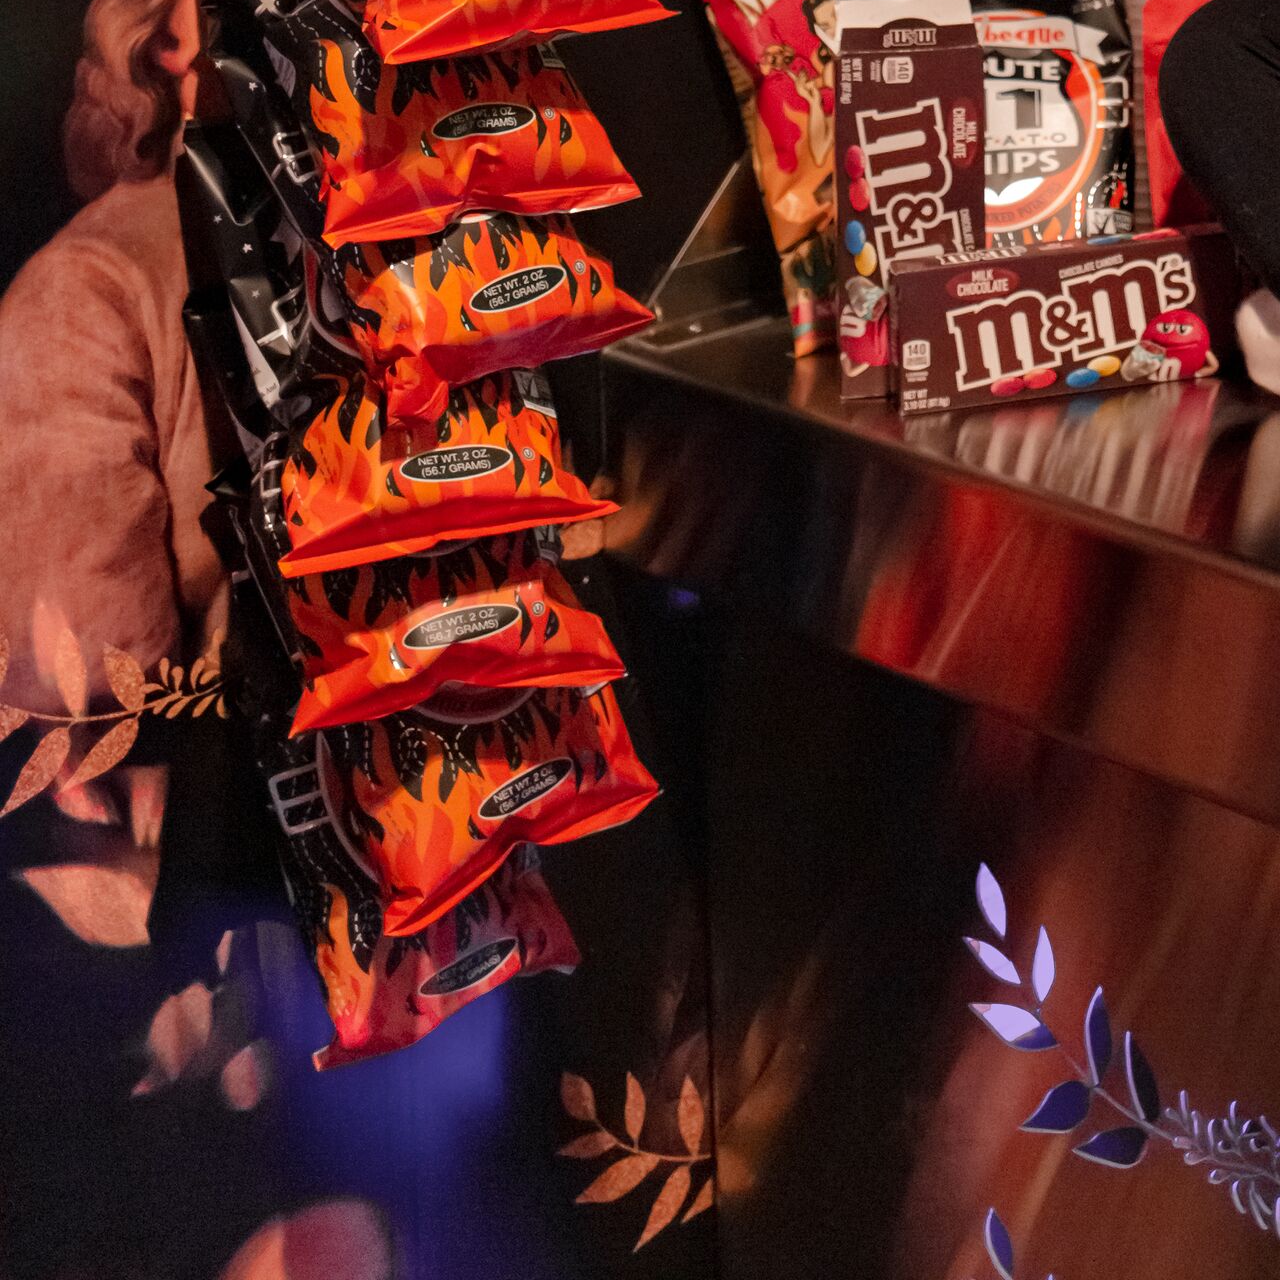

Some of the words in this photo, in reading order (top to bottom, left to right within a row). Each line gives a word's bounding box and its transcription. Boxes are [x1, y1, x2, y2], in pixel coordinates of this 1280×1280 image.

[984, 23, 1065, 47] beque
[897, 61, 910, 80] 140
[983, 56, 1061, 81] UTE
[953, 107, 966, 159] CHOCOLATE
[966, 121, 977, 143] MILK
[971, 269, 994, 282] MILK
[957, 280, 1009, 297] CHOCOLATE
[907, 343, 927, 357] 140
